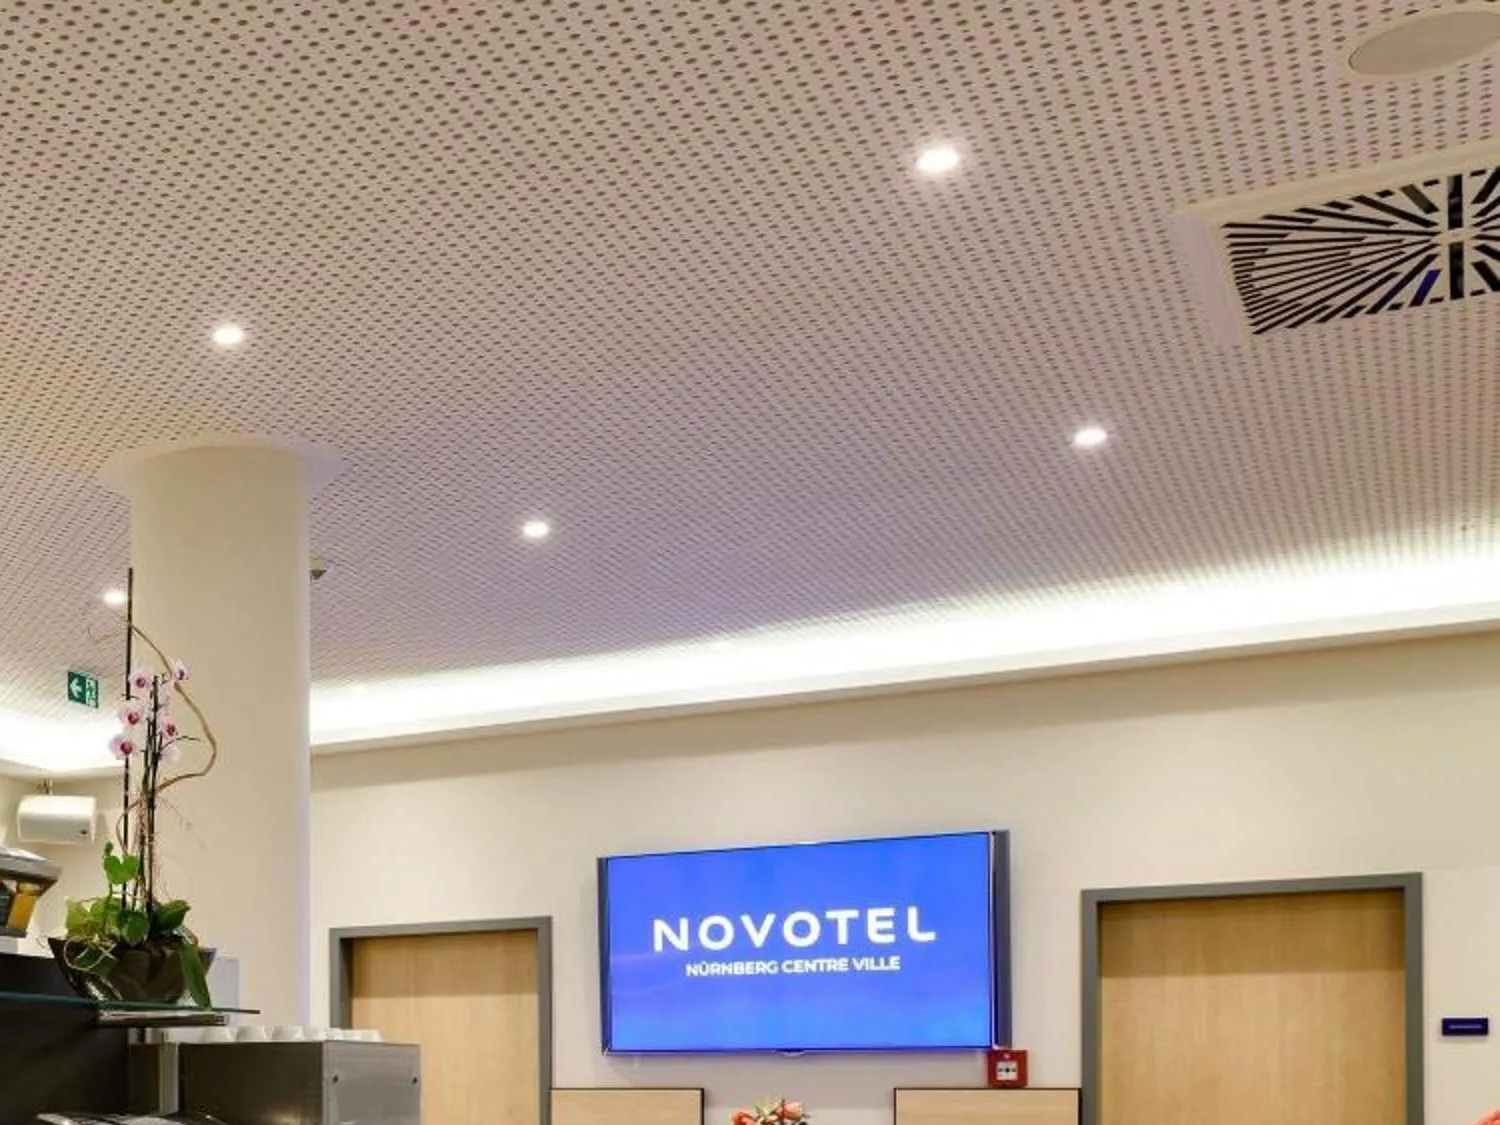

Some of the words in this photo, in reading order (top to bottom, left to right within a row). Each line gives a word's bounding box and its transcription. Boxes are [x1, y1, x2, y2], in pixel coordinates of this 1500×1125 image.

[653, 905, 937, 952] NOVOTEL
[685, 960, 778, 977] NÜRNBERG
[781, 957, 849, 974] CENTRE
[852, 955, 901, 972] VILLE
